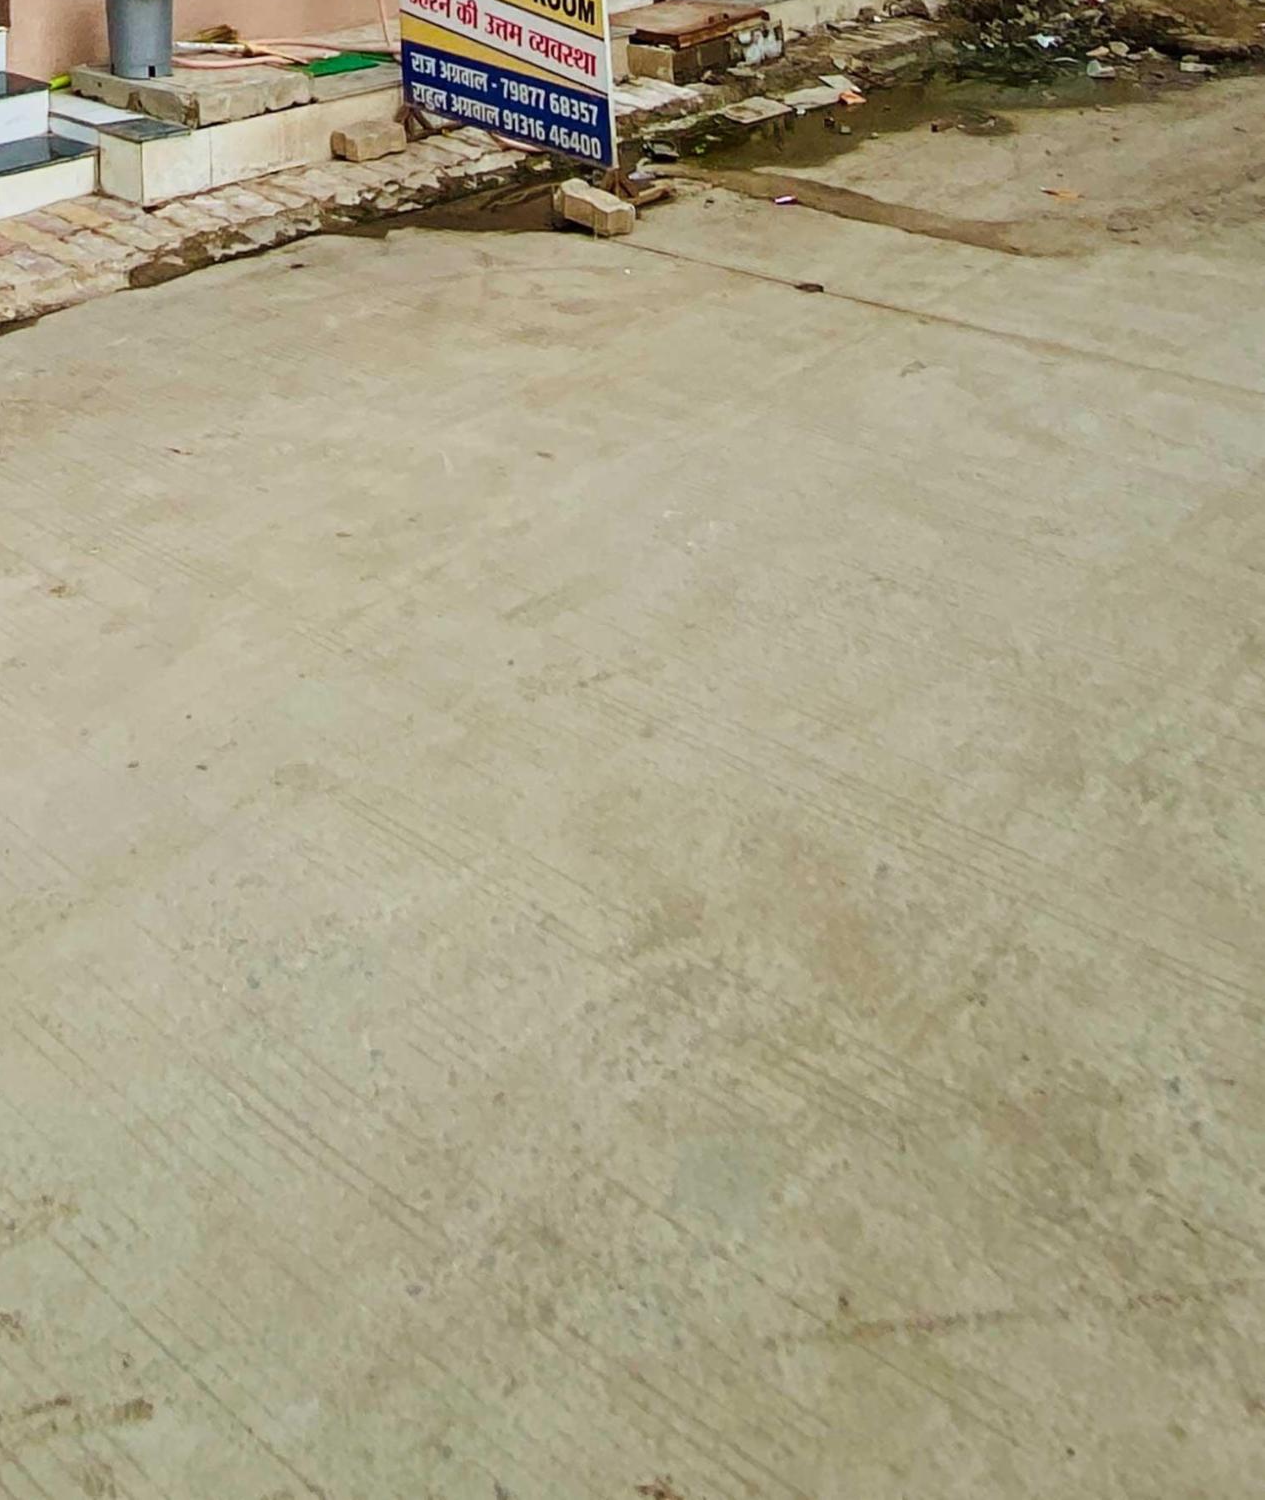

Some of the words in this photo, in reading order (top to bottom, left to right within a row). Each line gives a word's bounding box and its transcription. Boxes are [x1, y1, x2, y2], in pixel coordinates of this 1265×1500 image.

[484, 12, 523, 47] उत्तम
[528, 29, 597, 77] व्यवस्था
[409, 52, 437, 77] राज
[439, 60, 488, 93] अग्रवाल
[499, 78, 546, 110] 79877
[549, 92, 599, 126] 68357
[411, 82, 447, 112] राहुल
[450, 93, 500, 127] अग्रवाल
[502, 110, 546, 141] 91316
[549, 125, 602, 160] 46400
